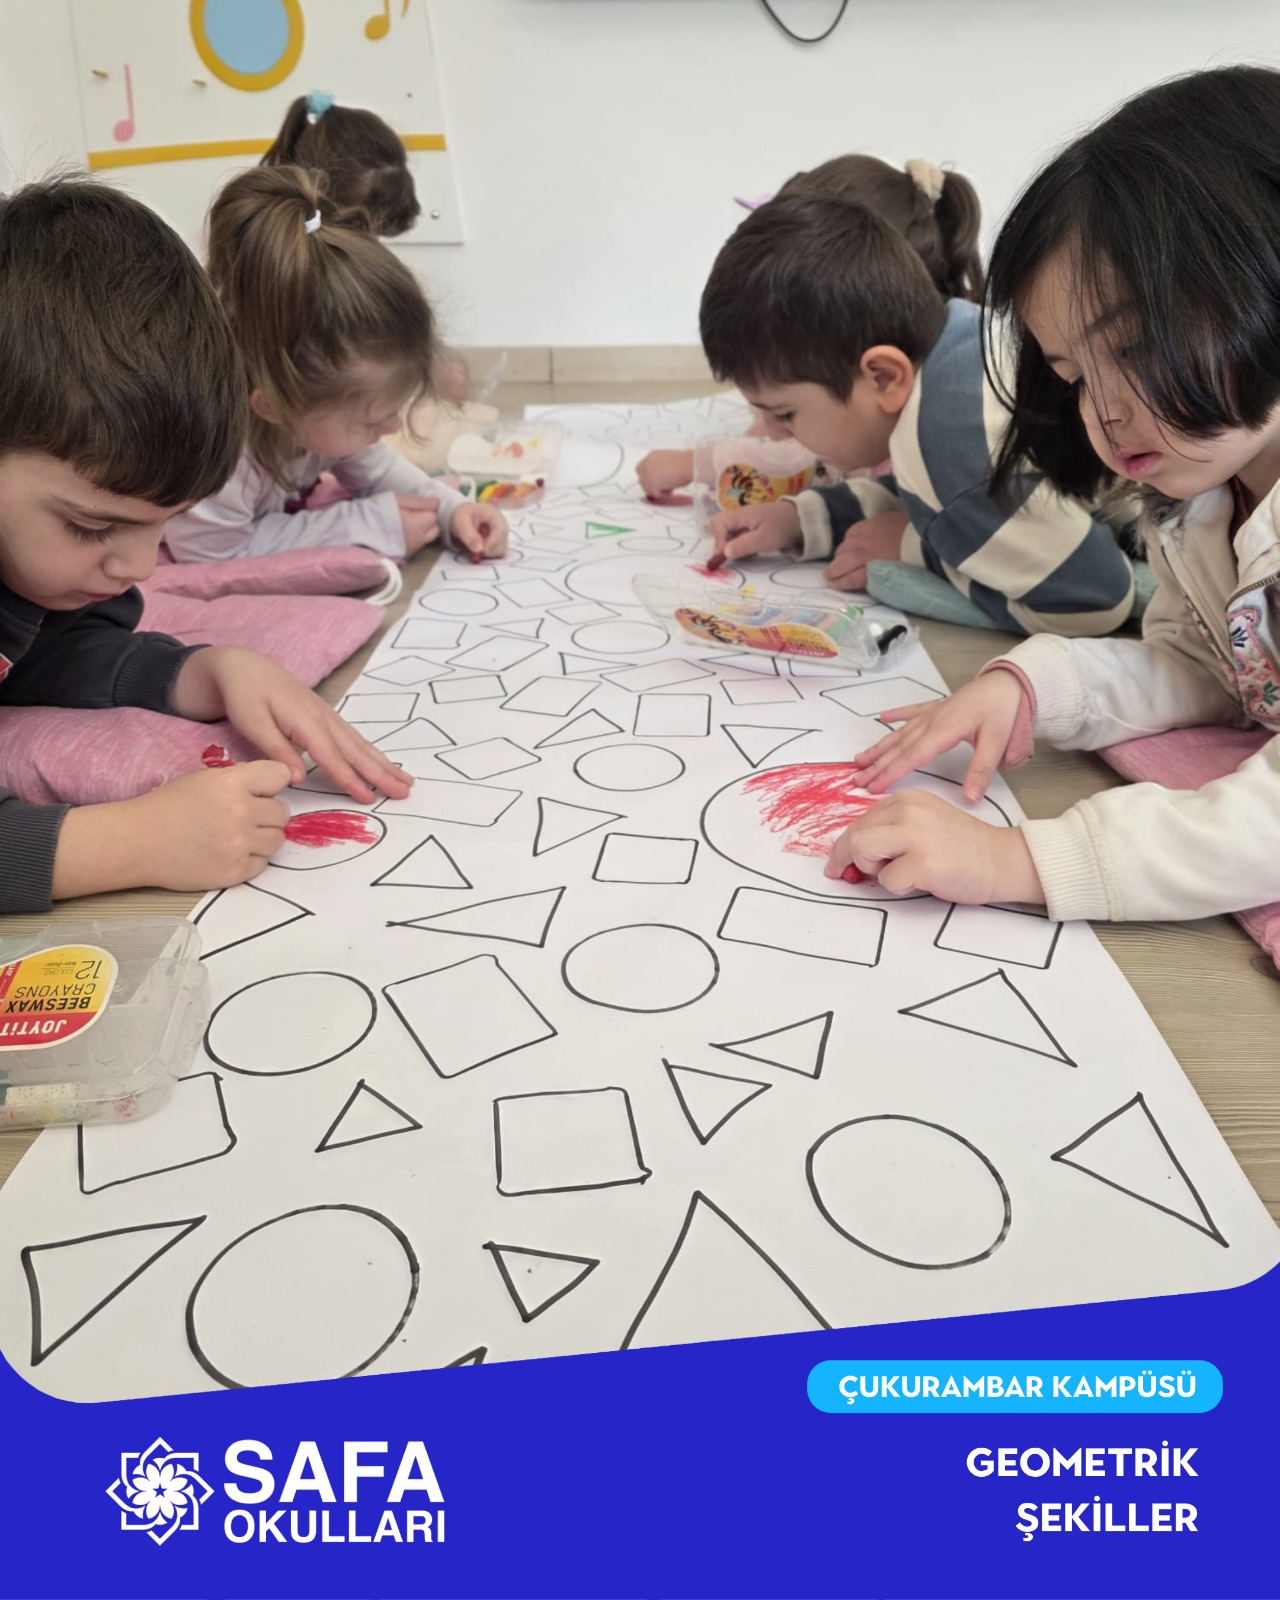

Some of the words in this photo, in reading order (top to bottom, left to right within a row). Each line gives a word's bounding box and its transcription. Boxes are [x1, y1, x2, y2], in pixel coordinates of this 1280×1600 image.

[43, 968, 74, 976] COLORS
[75, 960, 103, 980] 12
[14, 982, 97, 999] CRAYONS
[5, 996, 92, 1014] BEESWAX
